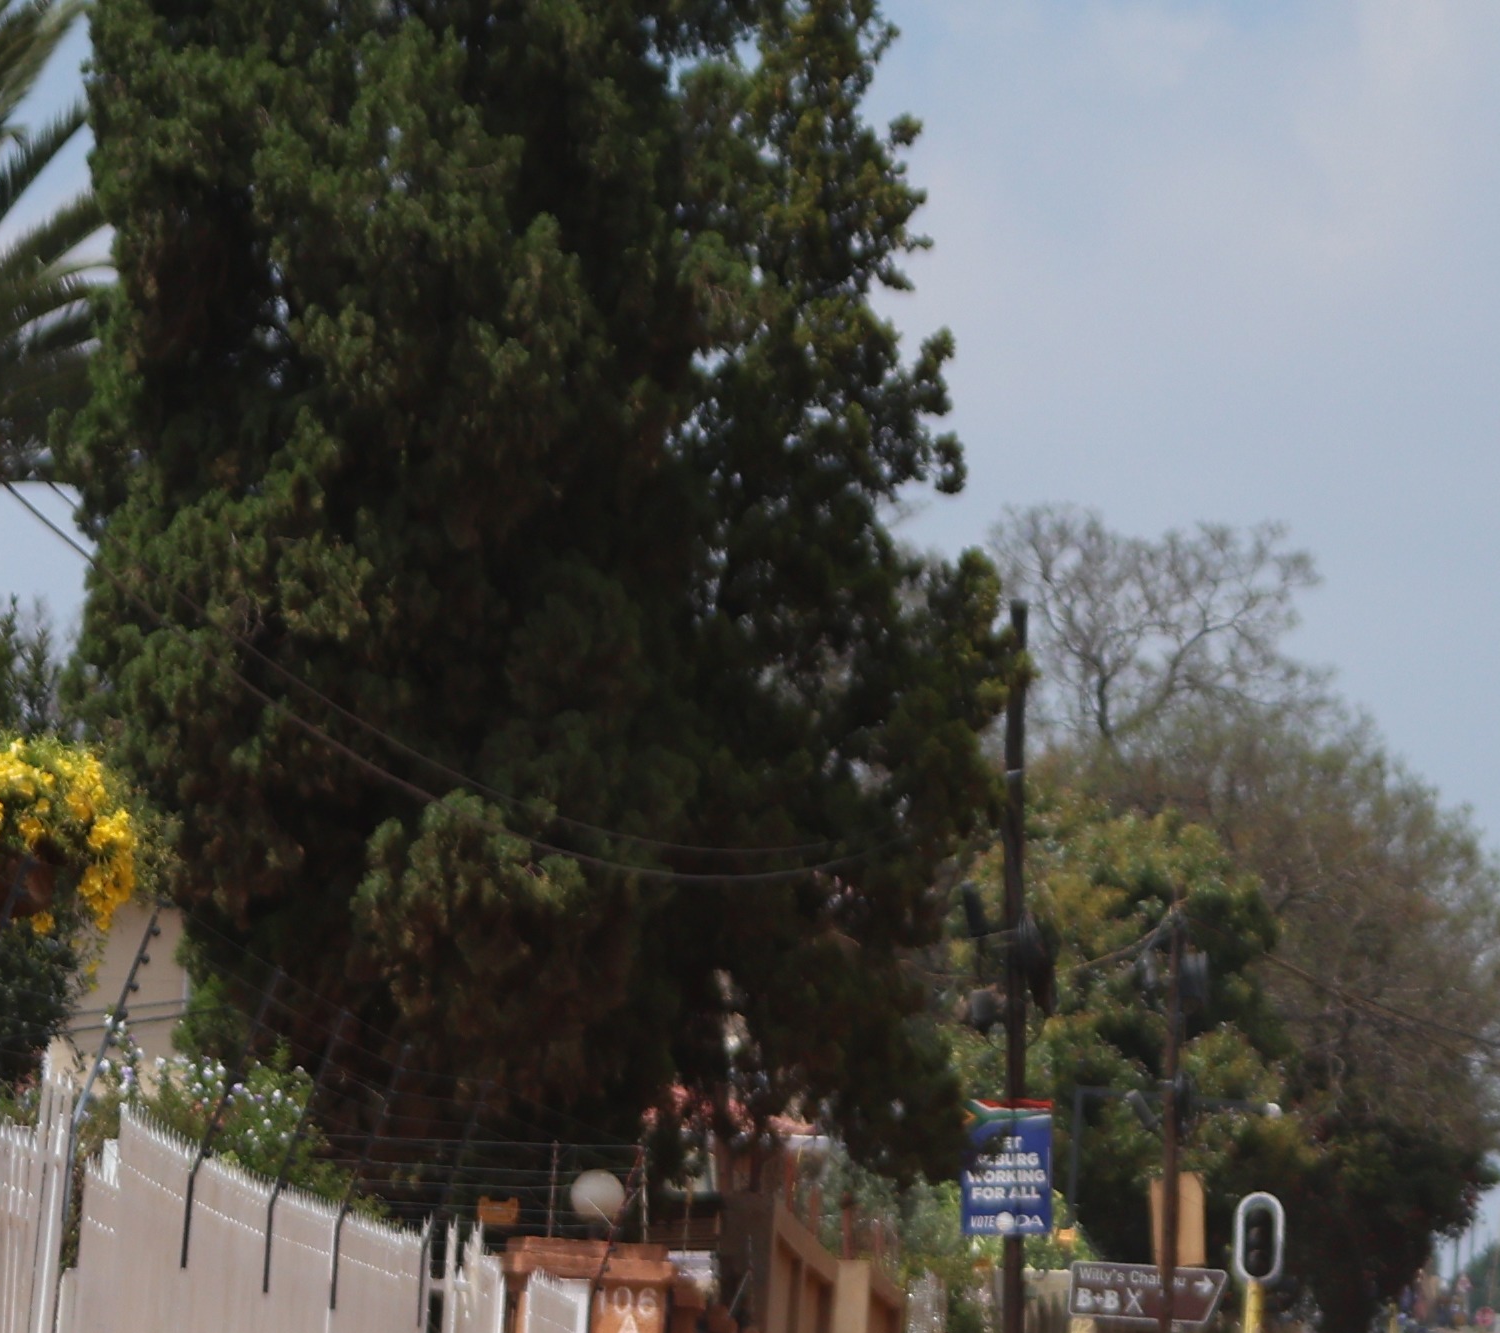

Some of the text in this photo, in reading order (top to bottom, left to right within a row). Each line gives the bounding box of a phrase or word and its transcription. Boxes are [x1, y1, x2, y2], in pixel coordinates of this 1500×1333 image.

[971, 1185, 1041, 1199] FOR ALL
[971, 1214, 1044, 1228] VOTE DA
[1079, 1267, 1125, 1285] Willy's
[597, 1286, 657, 1317] 106
